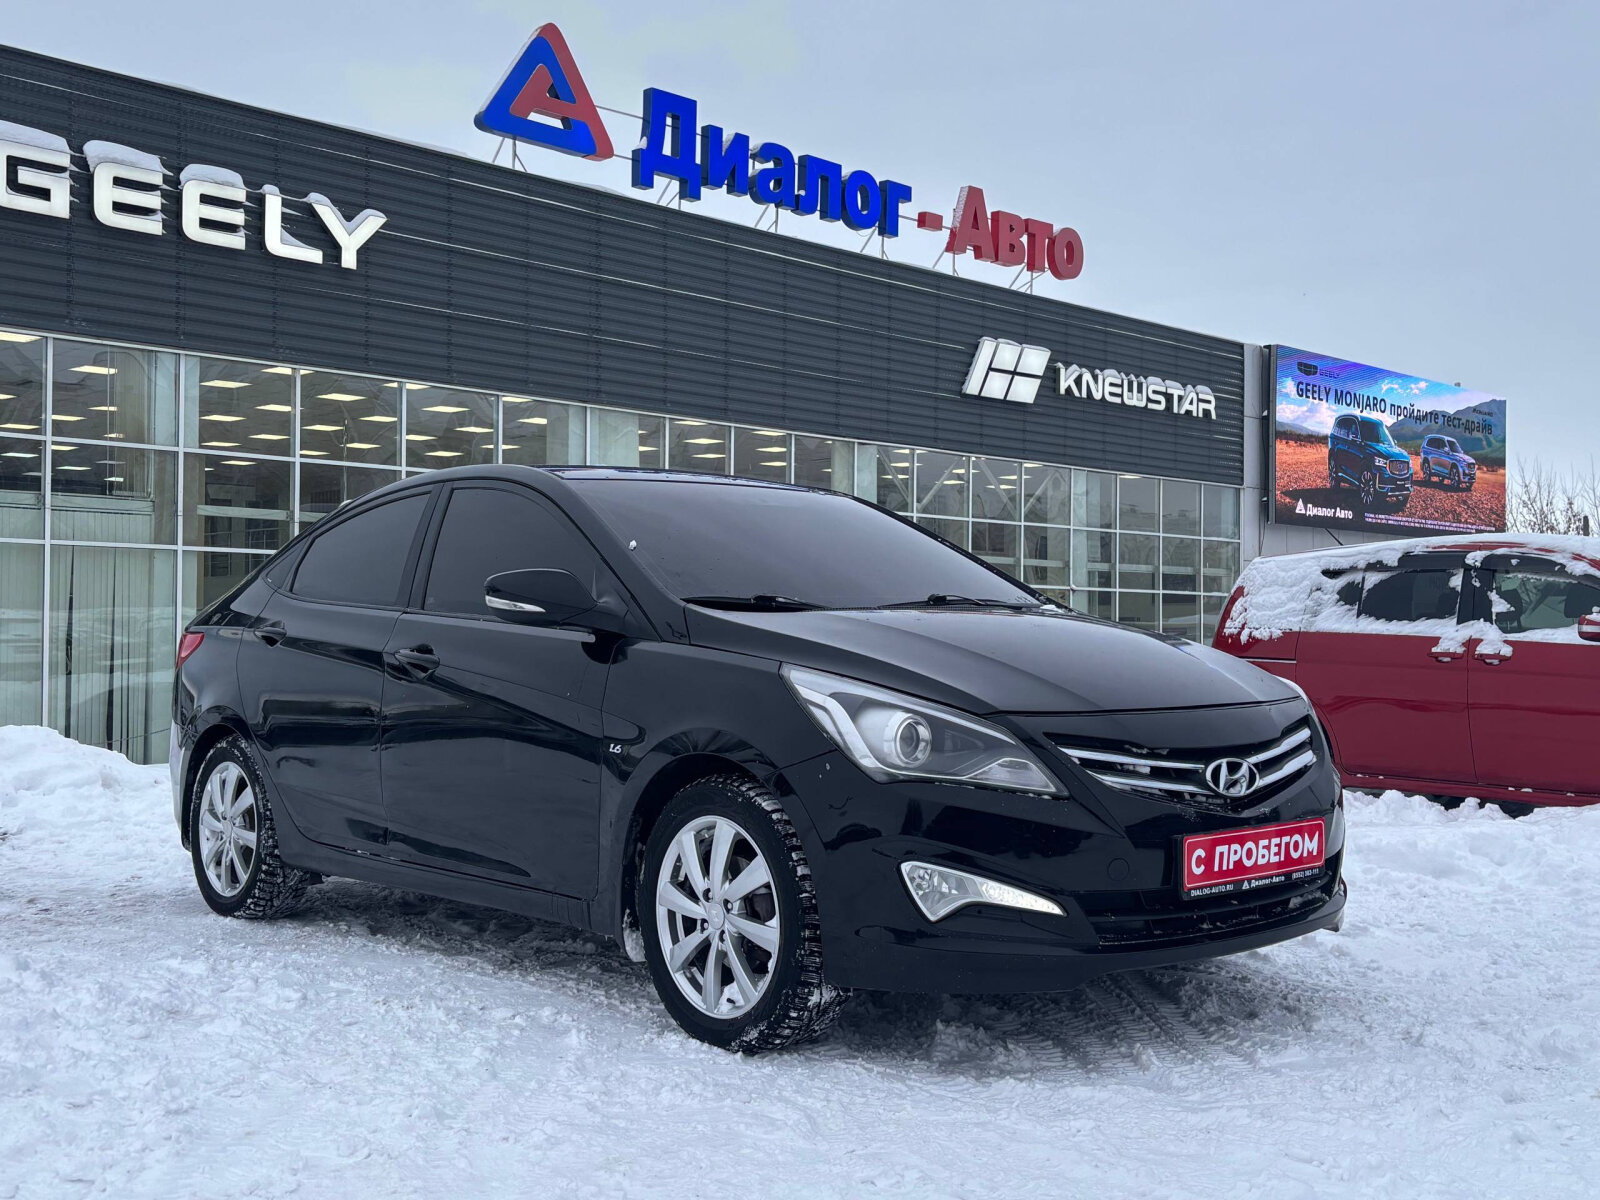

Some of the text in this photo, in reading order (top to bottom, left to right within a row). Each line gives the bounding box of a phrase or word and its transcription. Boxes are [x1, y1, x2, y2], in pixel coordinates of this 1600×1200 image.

[0, 139, 387, 269] GEELY
[1058, 363, 1216, 419] KNEWSTAR
[1296, 381, 1493, 436] GEELY MONJARO пройдите тест-драйв
[1306, 503, 1353, 519] Диалог Авто
[1191, 831, 1319, 875] С ПРОБЕГОМ
[1190, 883, 1234, 897] DIALOG-AUTO.RU
